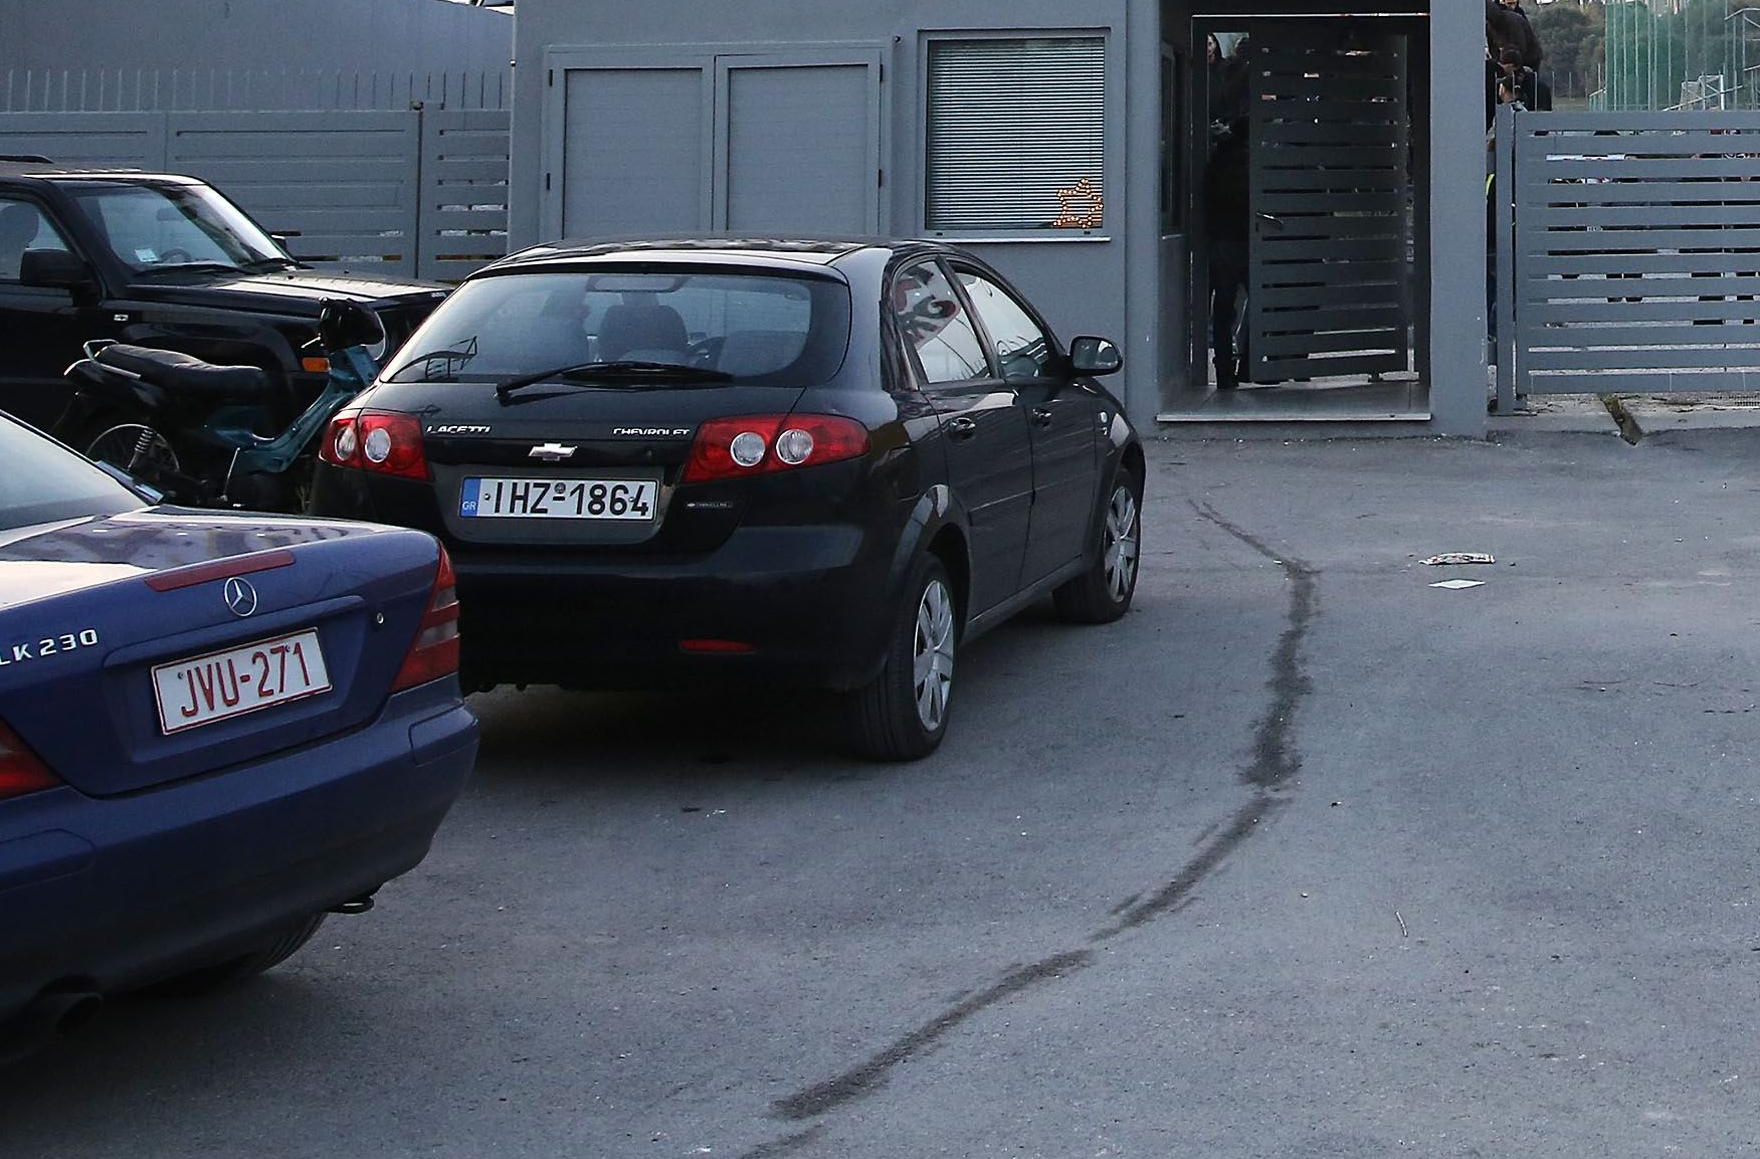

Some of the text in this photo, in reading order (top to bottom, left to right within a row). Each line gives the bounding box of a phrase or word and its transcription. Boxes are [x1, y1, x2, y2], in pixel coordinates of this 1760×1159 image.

[461, 501, 477, 512] GR
[494, 482, 649, 515] IHZ-1864
[39, 629, 98, 657] 230
[181, 642, 310, 717] JVU-271
